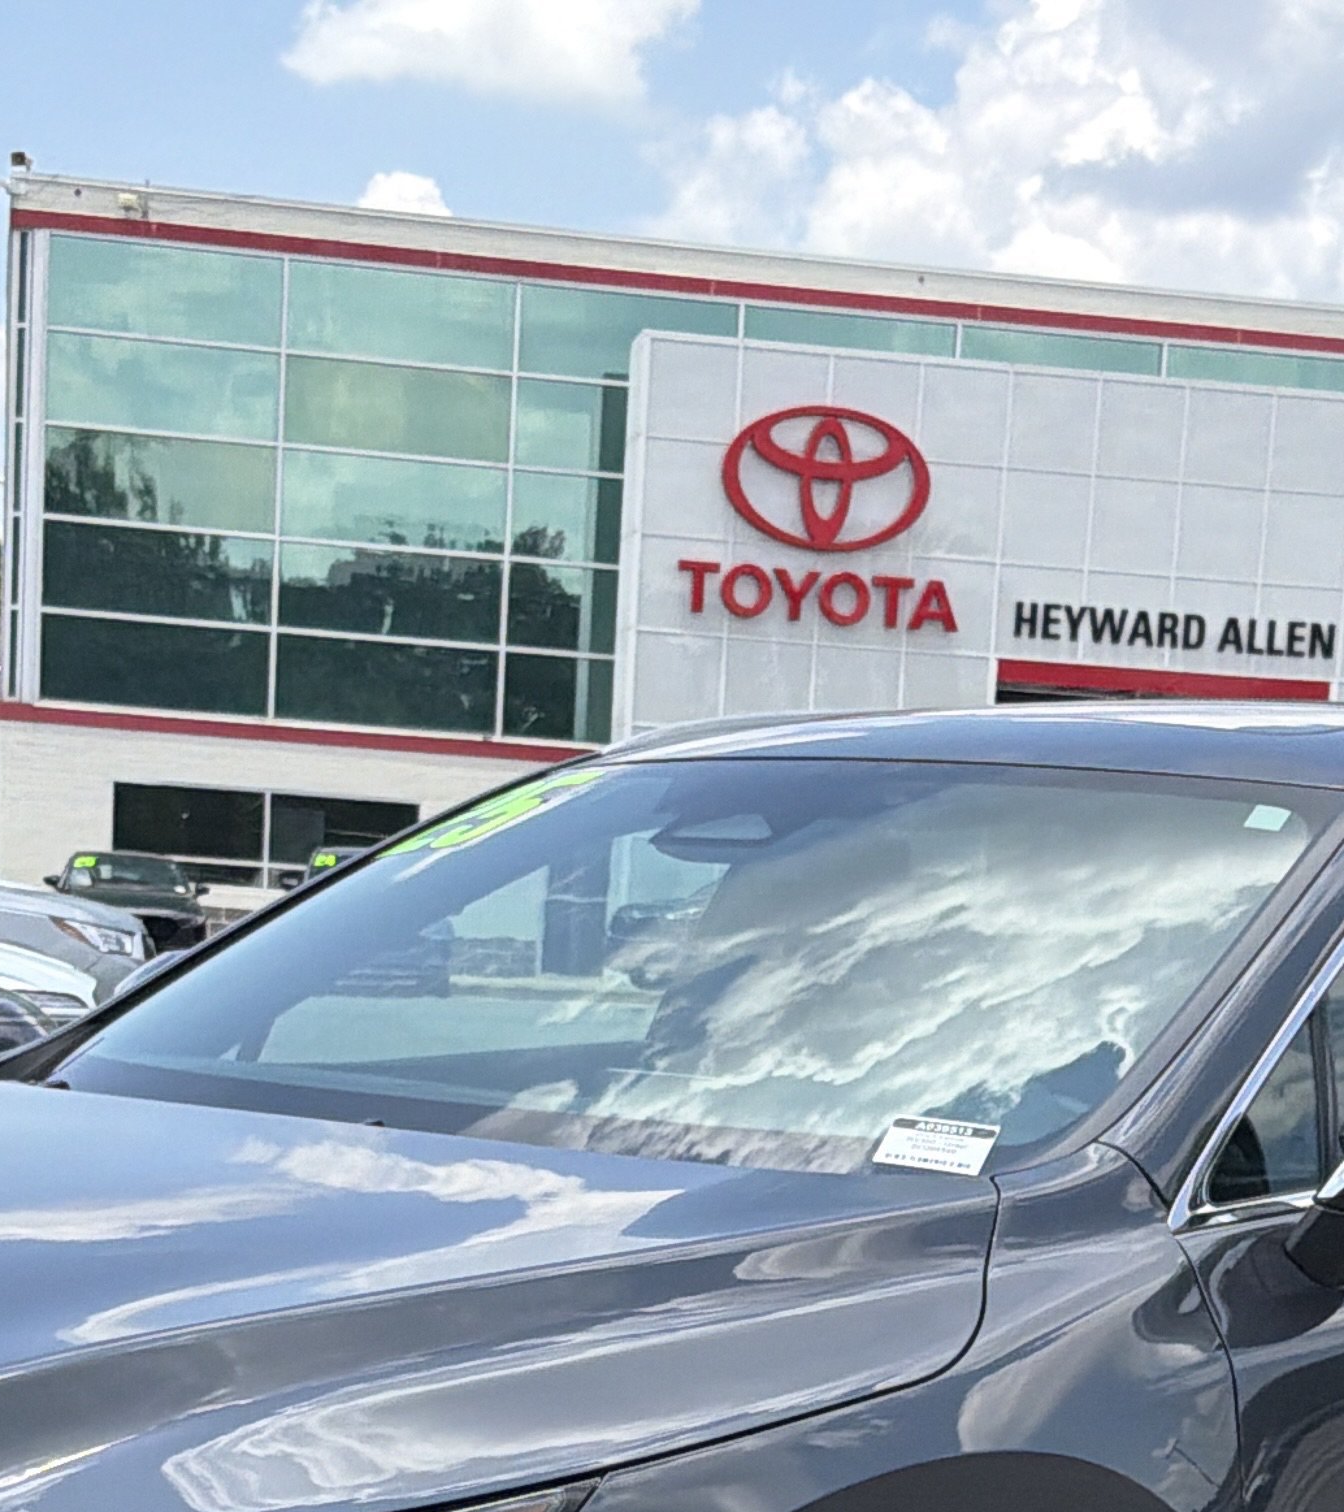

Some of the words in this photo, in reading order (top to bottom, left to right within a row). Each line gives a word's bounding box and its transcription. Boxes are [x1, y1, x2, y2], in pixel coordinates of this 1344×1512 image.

[678, 560, 958, 632] TOYOTA
[1013, 601, 1206, 650] HEYWARD
[1217, 617, 1336, 659] ALLEN
